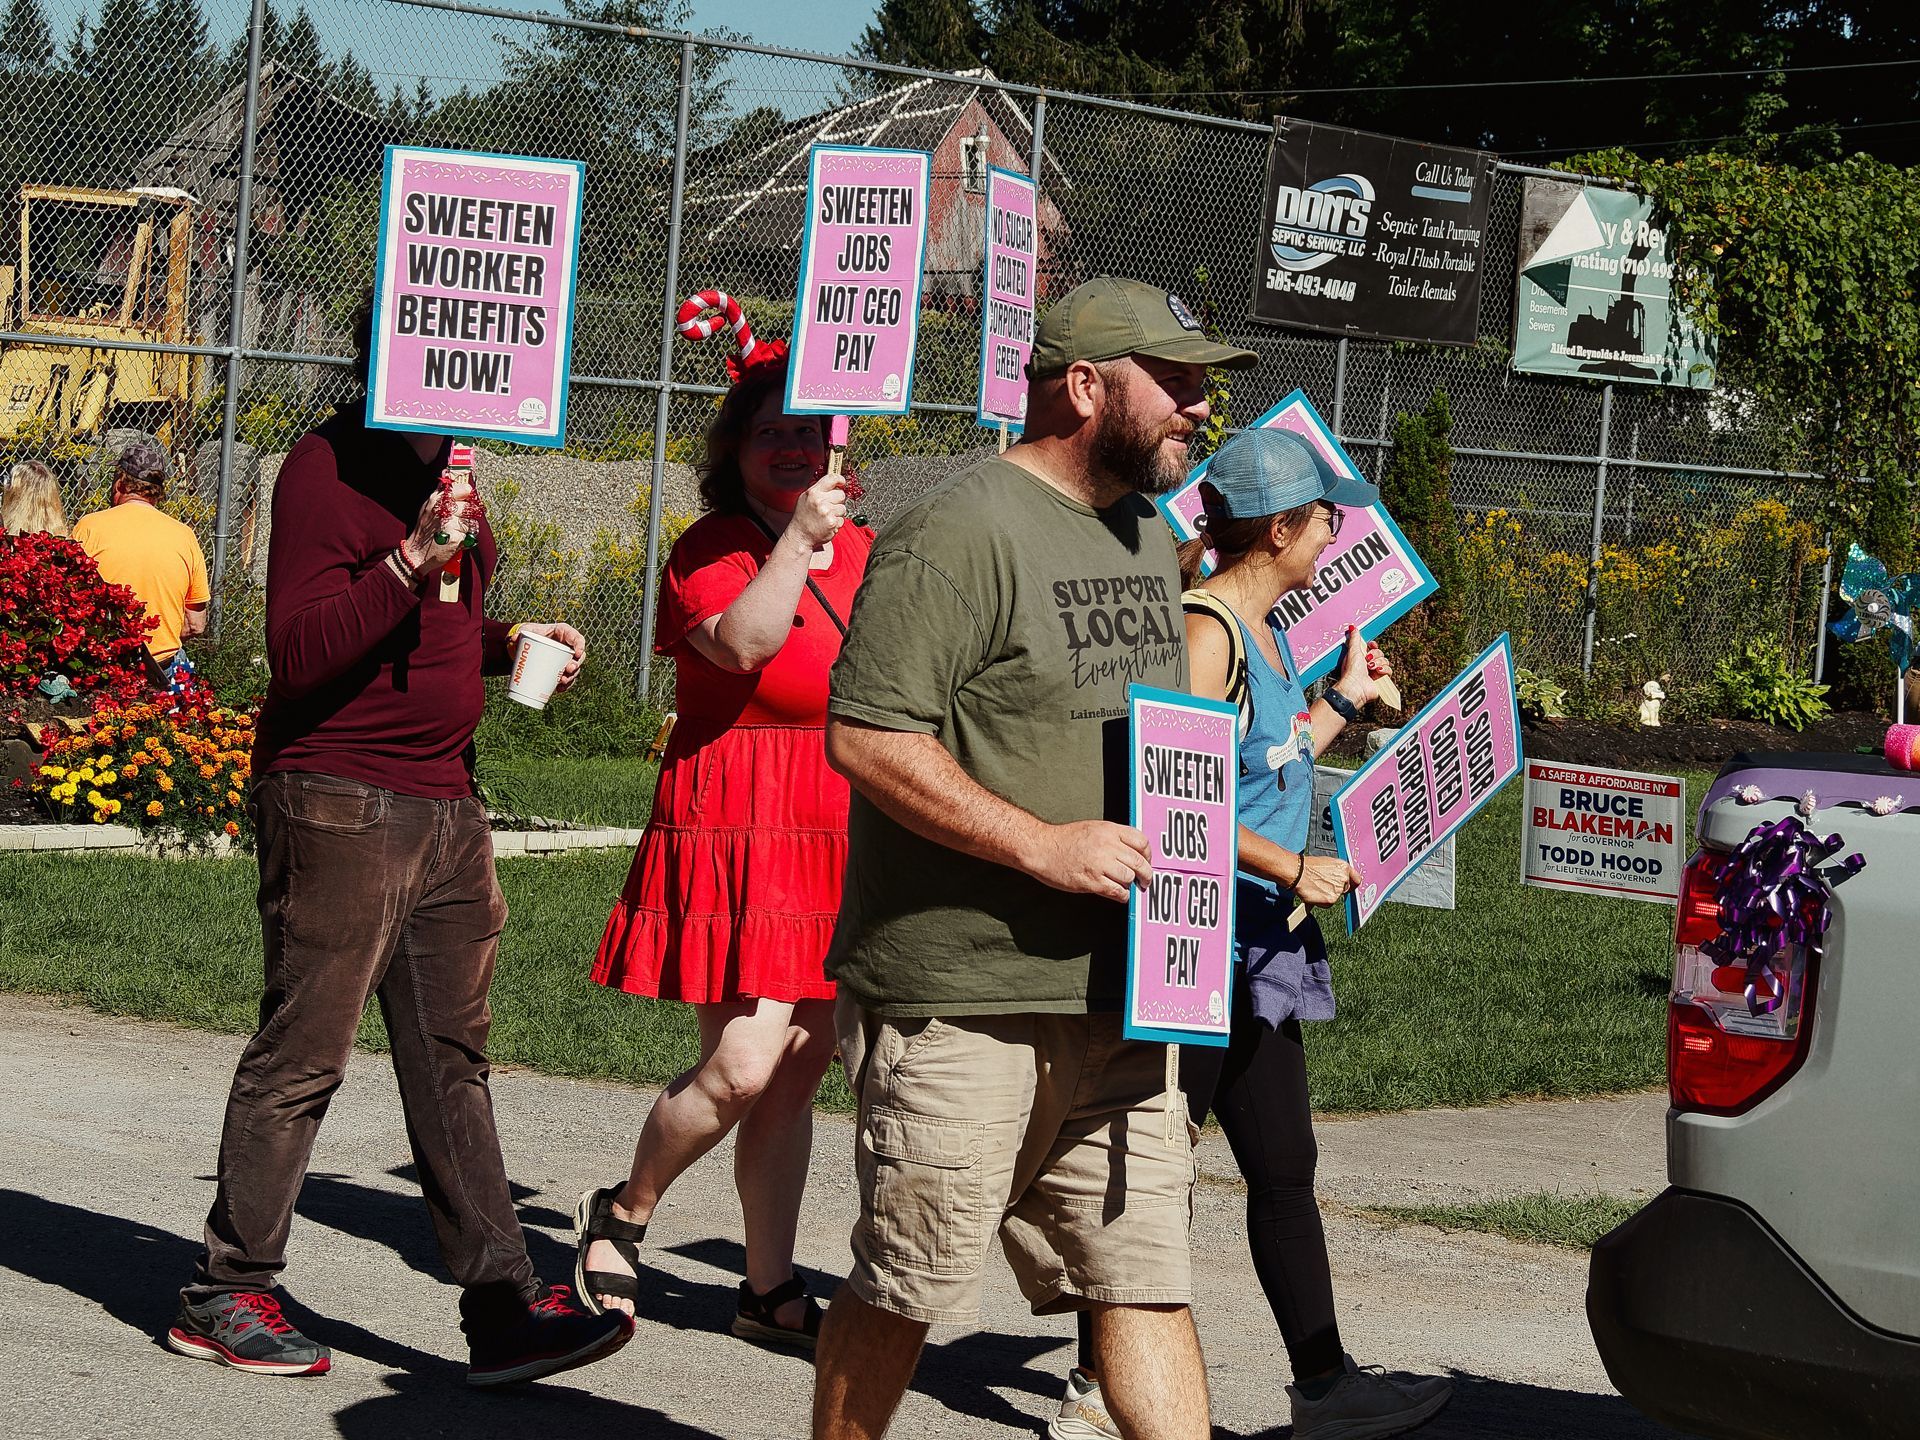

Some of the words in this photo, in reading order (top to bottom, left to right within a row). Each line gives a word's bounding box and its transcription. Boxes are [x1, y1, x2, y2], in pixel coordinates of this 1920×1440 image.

[1415, 161, 1438, 184] Call
[1440, 165, 1453, 183] Us
[404, 192, 555, 247] SWEETEN
[821, 186, 912, 225] SWEETEN
[1275, 186, 1371, 237] DON'S
[993, 207, 1003, 244] NO
[1005, 209, 1033, 254] SUGAR
[1271, 229, 1305, 248] SEPTIC
[1306, 233, 1347, 256] SERVICE,
[1348, 242, 1366, 257] LLC
[1421, 217, 1444, 240] Tank
[1446, 222, 1481, 247] Pumping
[1620, 218, 1634, 245] &
[408, 244, 546, 297] WORKER
[837, 234, 891, 272] JOBS
[1412, 247, 1440, 270] Flush
[1441, 251, 1476, 272] Portable
[1620, 255, 1650, 276] (716)
[996, 254, 1027, 298] COATED
[1266, 268, 1357, 302] 585-493-4048
[1388, 275, 1420, 298] Toilet
[1420, 280, 1457, 301] Rentals
[397, 296, 546, 346] BENEFITS
[816, 285, 858, 325] NOT
[863, 288, 901, 326] CEO
[990, 301, 1031, 344] CORPORATE
[1528, 317, 1556, 333] Sewers
[424, 348, 512, 394] NOW!
[832, 333, 876, 372] PAY
[995, 343, 1020, 382] GREED
[1550, 342, 1576, 356] Alfred
[1576, 346, 1613, 360] Reynolds
[1620, 351, 1656, 364] Jeremiah
[1270, 530, 1392, 633] ONFECTION
[1059, 605, 1181, 650] LOCAL
[1069, 624, 1182, 703] Everything
[1458, 669, 1486, 720] NO
[1144, 744, 1224, 804] SWEETEN
[1429, 714, 1463, 818] COATED
[1464, 711, 1495, 804] SUGAR
[1396, 730, 1433, 864] CORPORATE
[1539, 769, 1546, 779] A
[1548, 770, 1577, 783] SAFER
[1579, 774, 1586, 784] &
[1588, 775, 1651, 792] AFFORDABLE
[1652, 783, 1668, 794] NY
[1370, 782, 1400, 864] GREED
[1560, 788, 1643, 818] BRUCE
[1161, 809, 1207, 862] JOBS
[1533, 806, 1673, 844] BLAKEMAN
[1567, 832, 1581, 844] for
[1582, 835, 1634, 849] GOVERNOR
[1539, 844, 1595, 867] TODD
[1601, 852, 1663, 876] HOOD
[1543, 862, 1556, 873] for
[1556, 865, 1608, 878] LIEUTENANT
[1609, 871, 1657, 885] GOVERNOR
[1148, 873, 1182, 924] NOT
[1188, 875, 1220, 929] CEO
[1165, 935, 1201, 988] PAY
